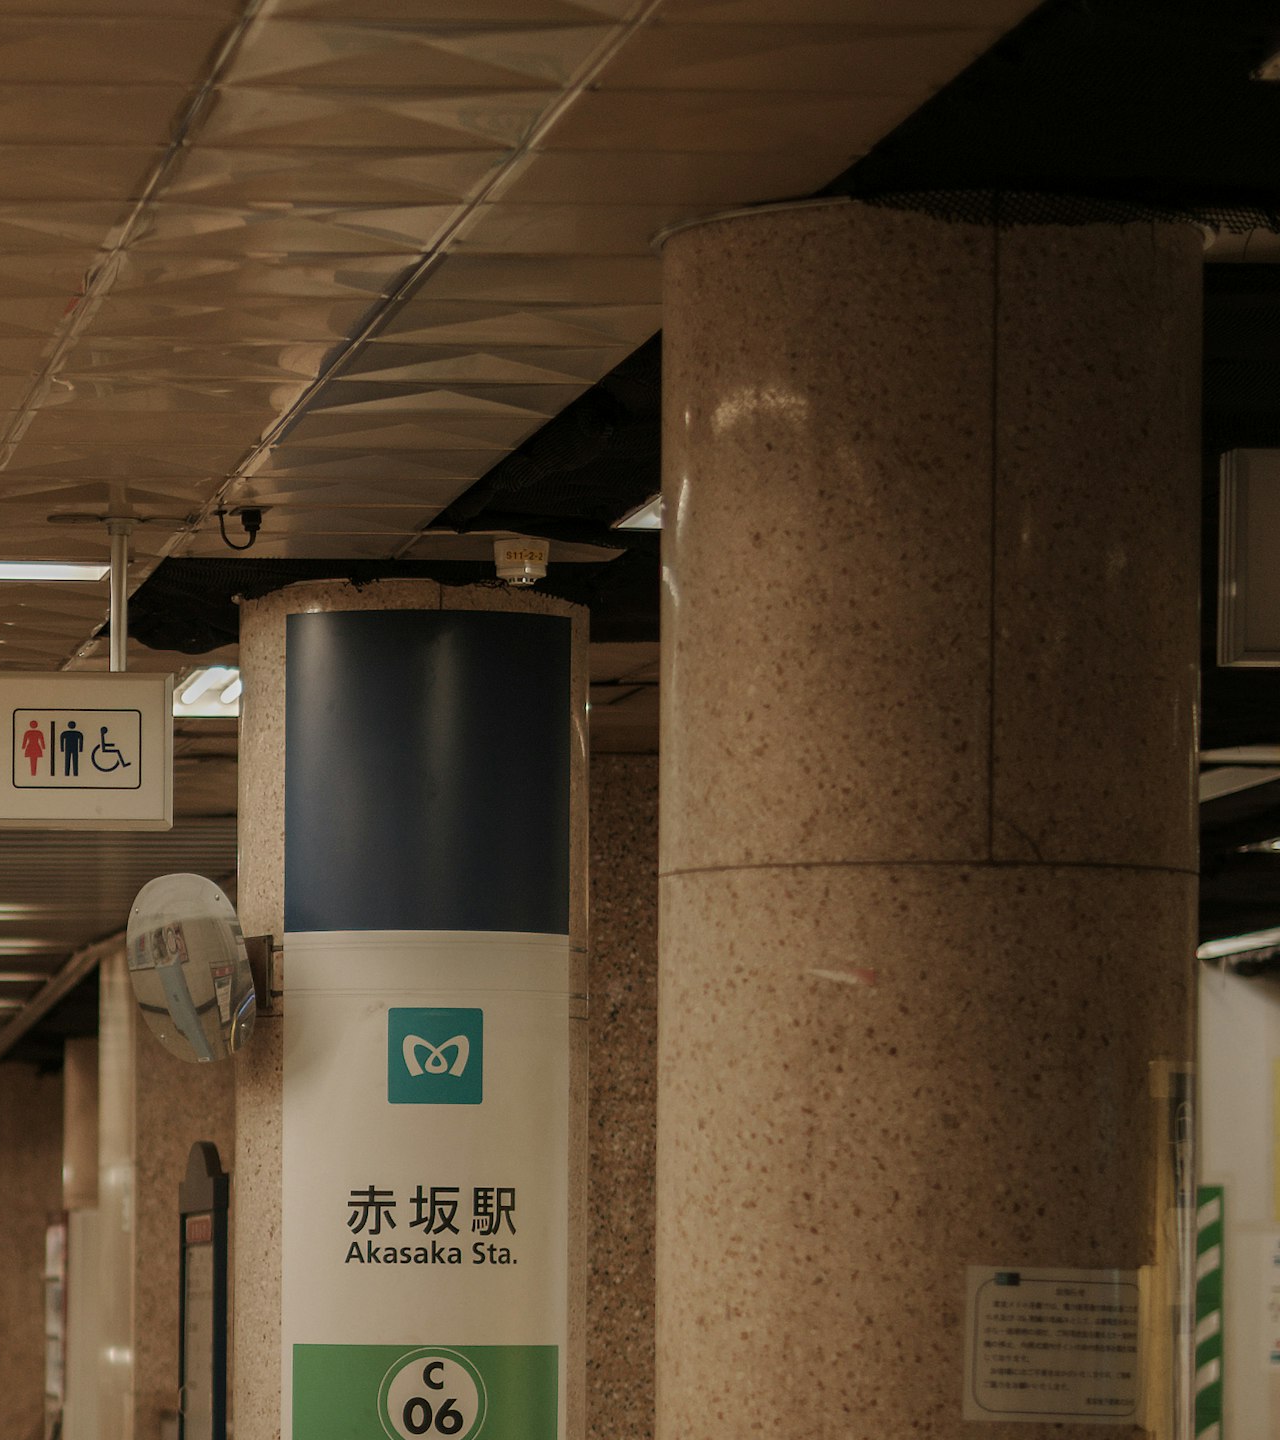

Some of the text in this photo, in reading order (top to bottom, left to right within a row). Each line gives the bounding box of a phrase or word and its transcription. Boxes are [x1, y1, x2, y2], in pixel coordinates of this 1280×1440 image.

[347, 1185, 517, 1236] 赤坂駅
[345, 1240, 518, 1265] Akasaka Sta.
[423, 1361, 444, 1390] C
[402, 1396, 464, 1435] 06
